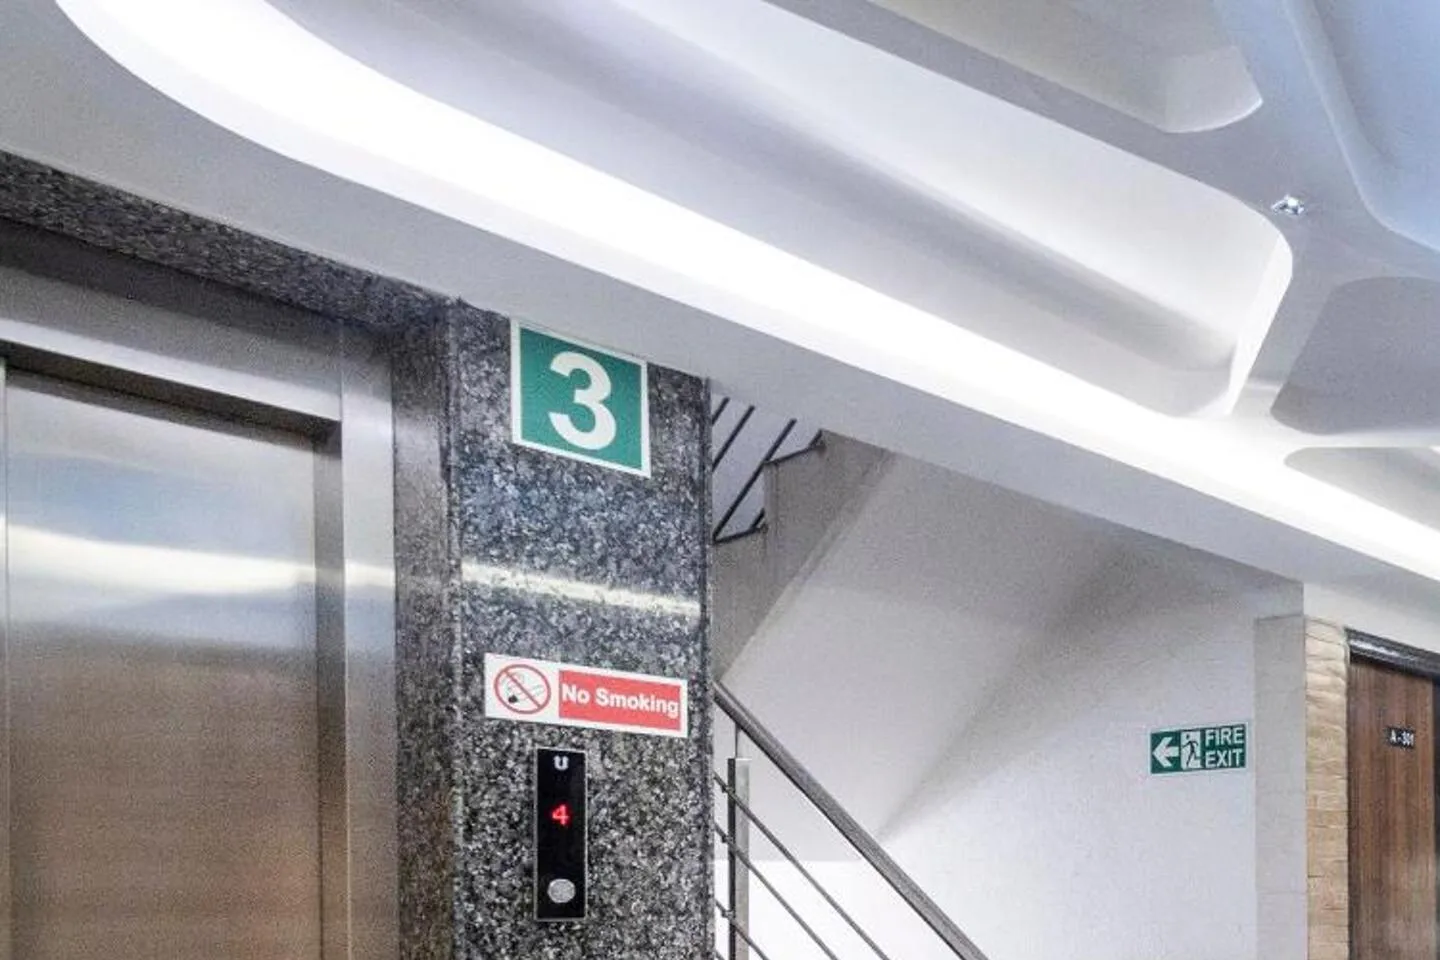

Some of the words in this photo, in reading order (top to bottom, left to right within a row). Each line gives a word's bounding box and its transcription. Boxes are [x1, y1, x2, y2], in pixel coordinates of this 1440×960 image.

[548, 351, 617, 450] 3
[561, 684, 590, 704] No
[596, 688, 679, 718] Smoking
[1205, 727, 1244, 747] FIRE
[1205, 749, 1243, 769] EXIT
[552, 804, 570, 825] 4
